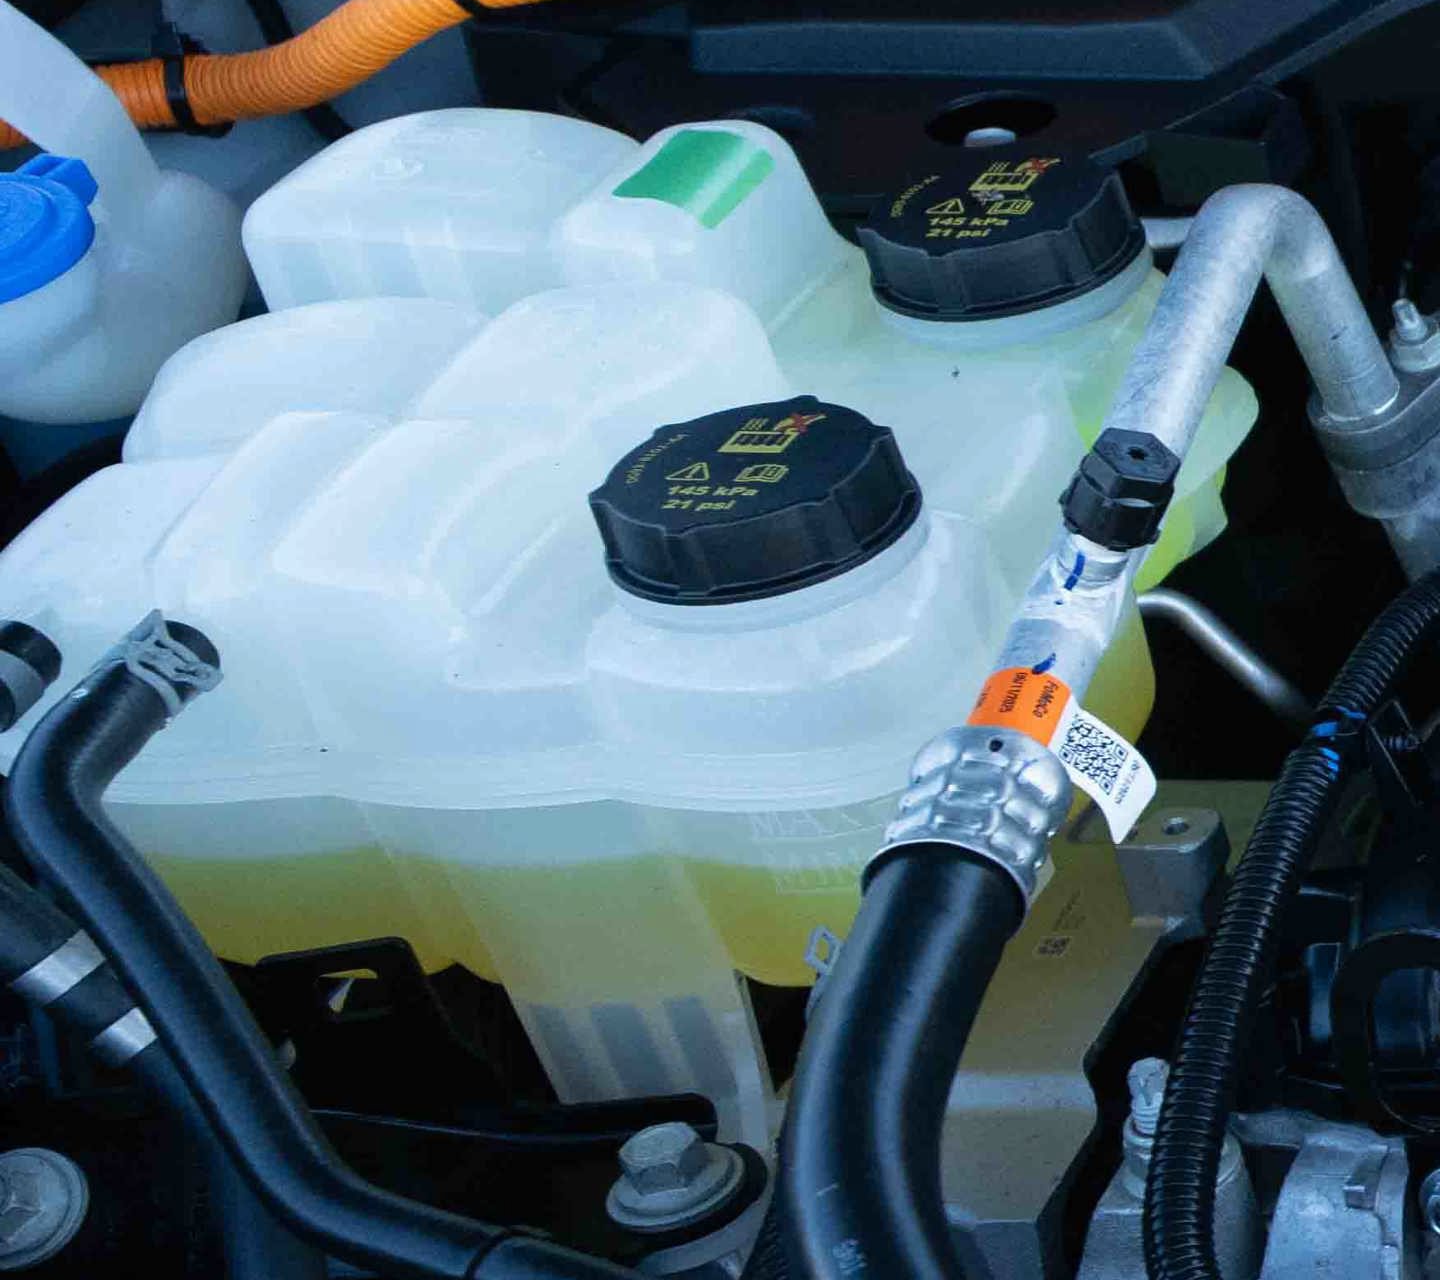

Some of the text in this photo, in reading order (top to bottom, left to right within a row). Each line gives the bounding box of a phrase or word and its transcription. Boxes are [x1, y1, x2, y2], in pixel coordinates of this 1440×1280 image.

[928, 216, 1010, 227] 145 kPa
[925, 228, 992, 239] 21 psi
[667, 485, 761, 497] 145 kPa
[660, 499, 738, 512] 21 psi
